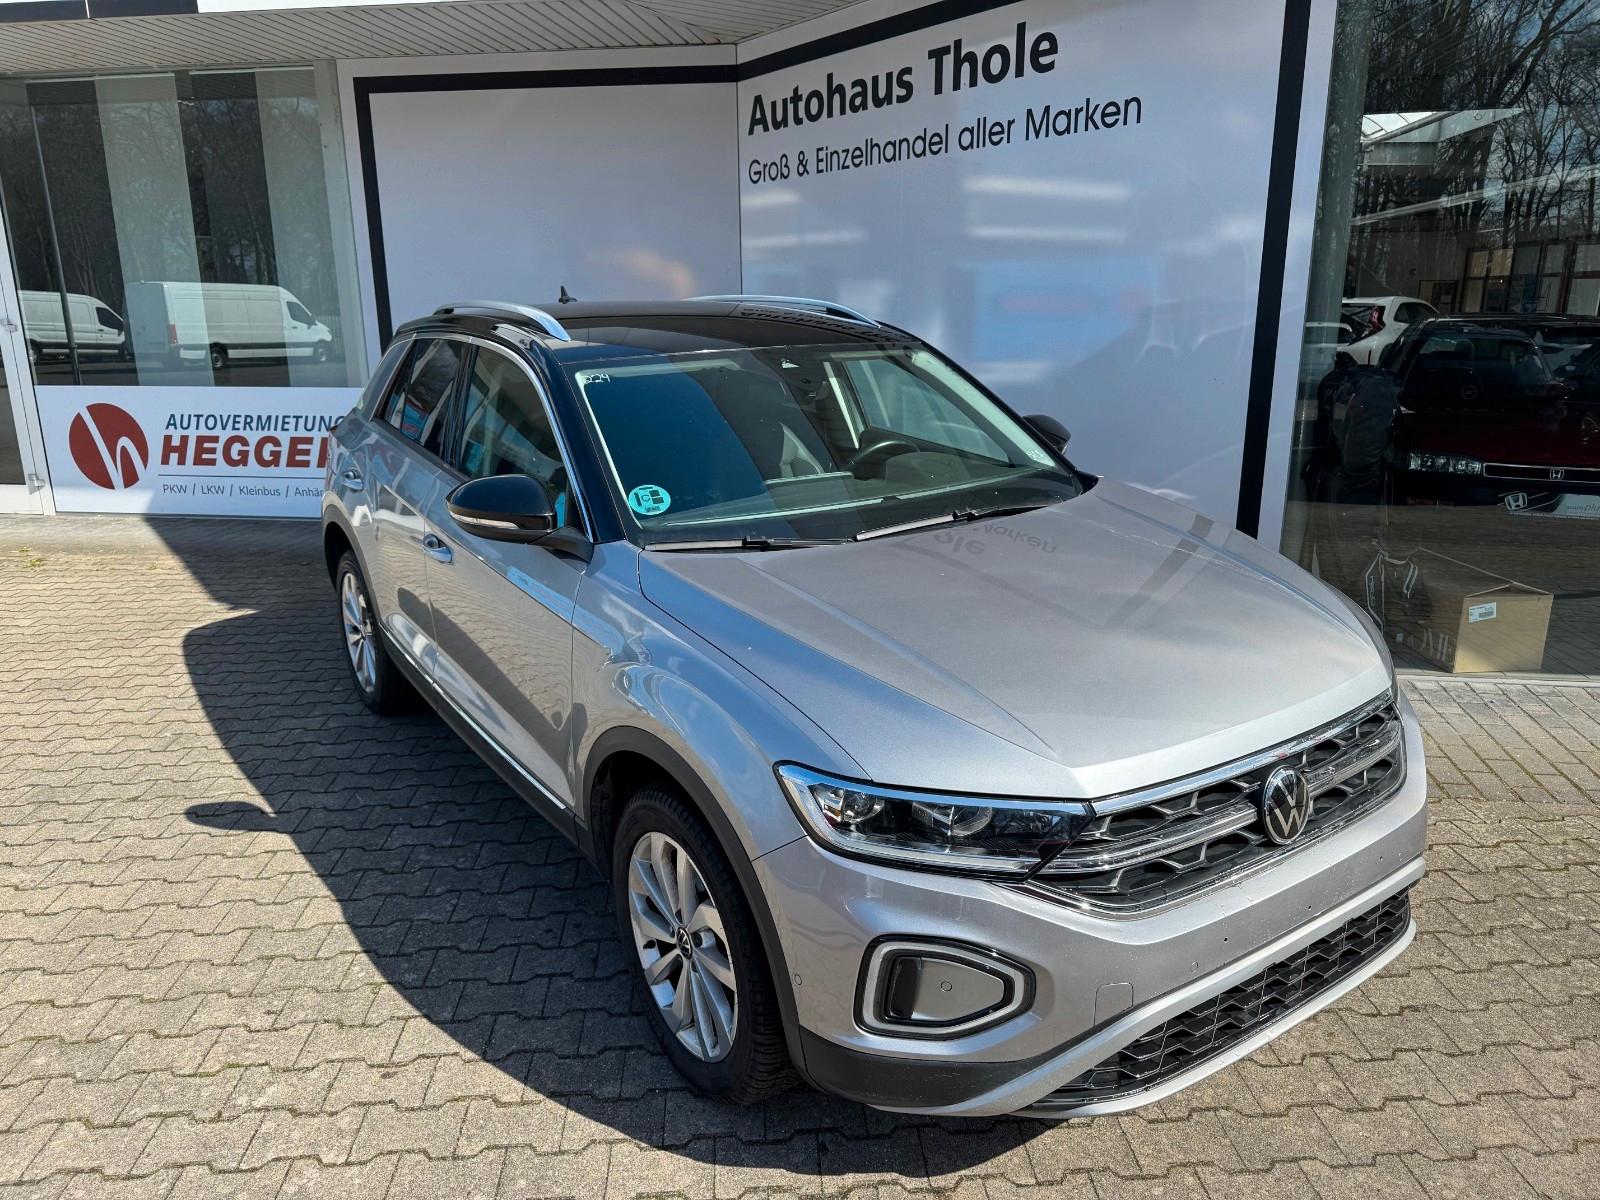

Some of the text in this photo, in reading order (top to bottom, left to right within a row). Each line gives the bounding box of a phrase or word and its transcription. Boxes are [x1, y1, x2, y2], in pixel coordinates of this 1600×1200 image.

[748, 22, 1058, 136] Autohaus Thole
[748, 96, 1141, 185] Groß & Einzelhandel aller Marken
[163, 484, 187, 494] PKW
[201, 485, 225, 495] LKW
[239, 485, 281, 497] Kleinbus
